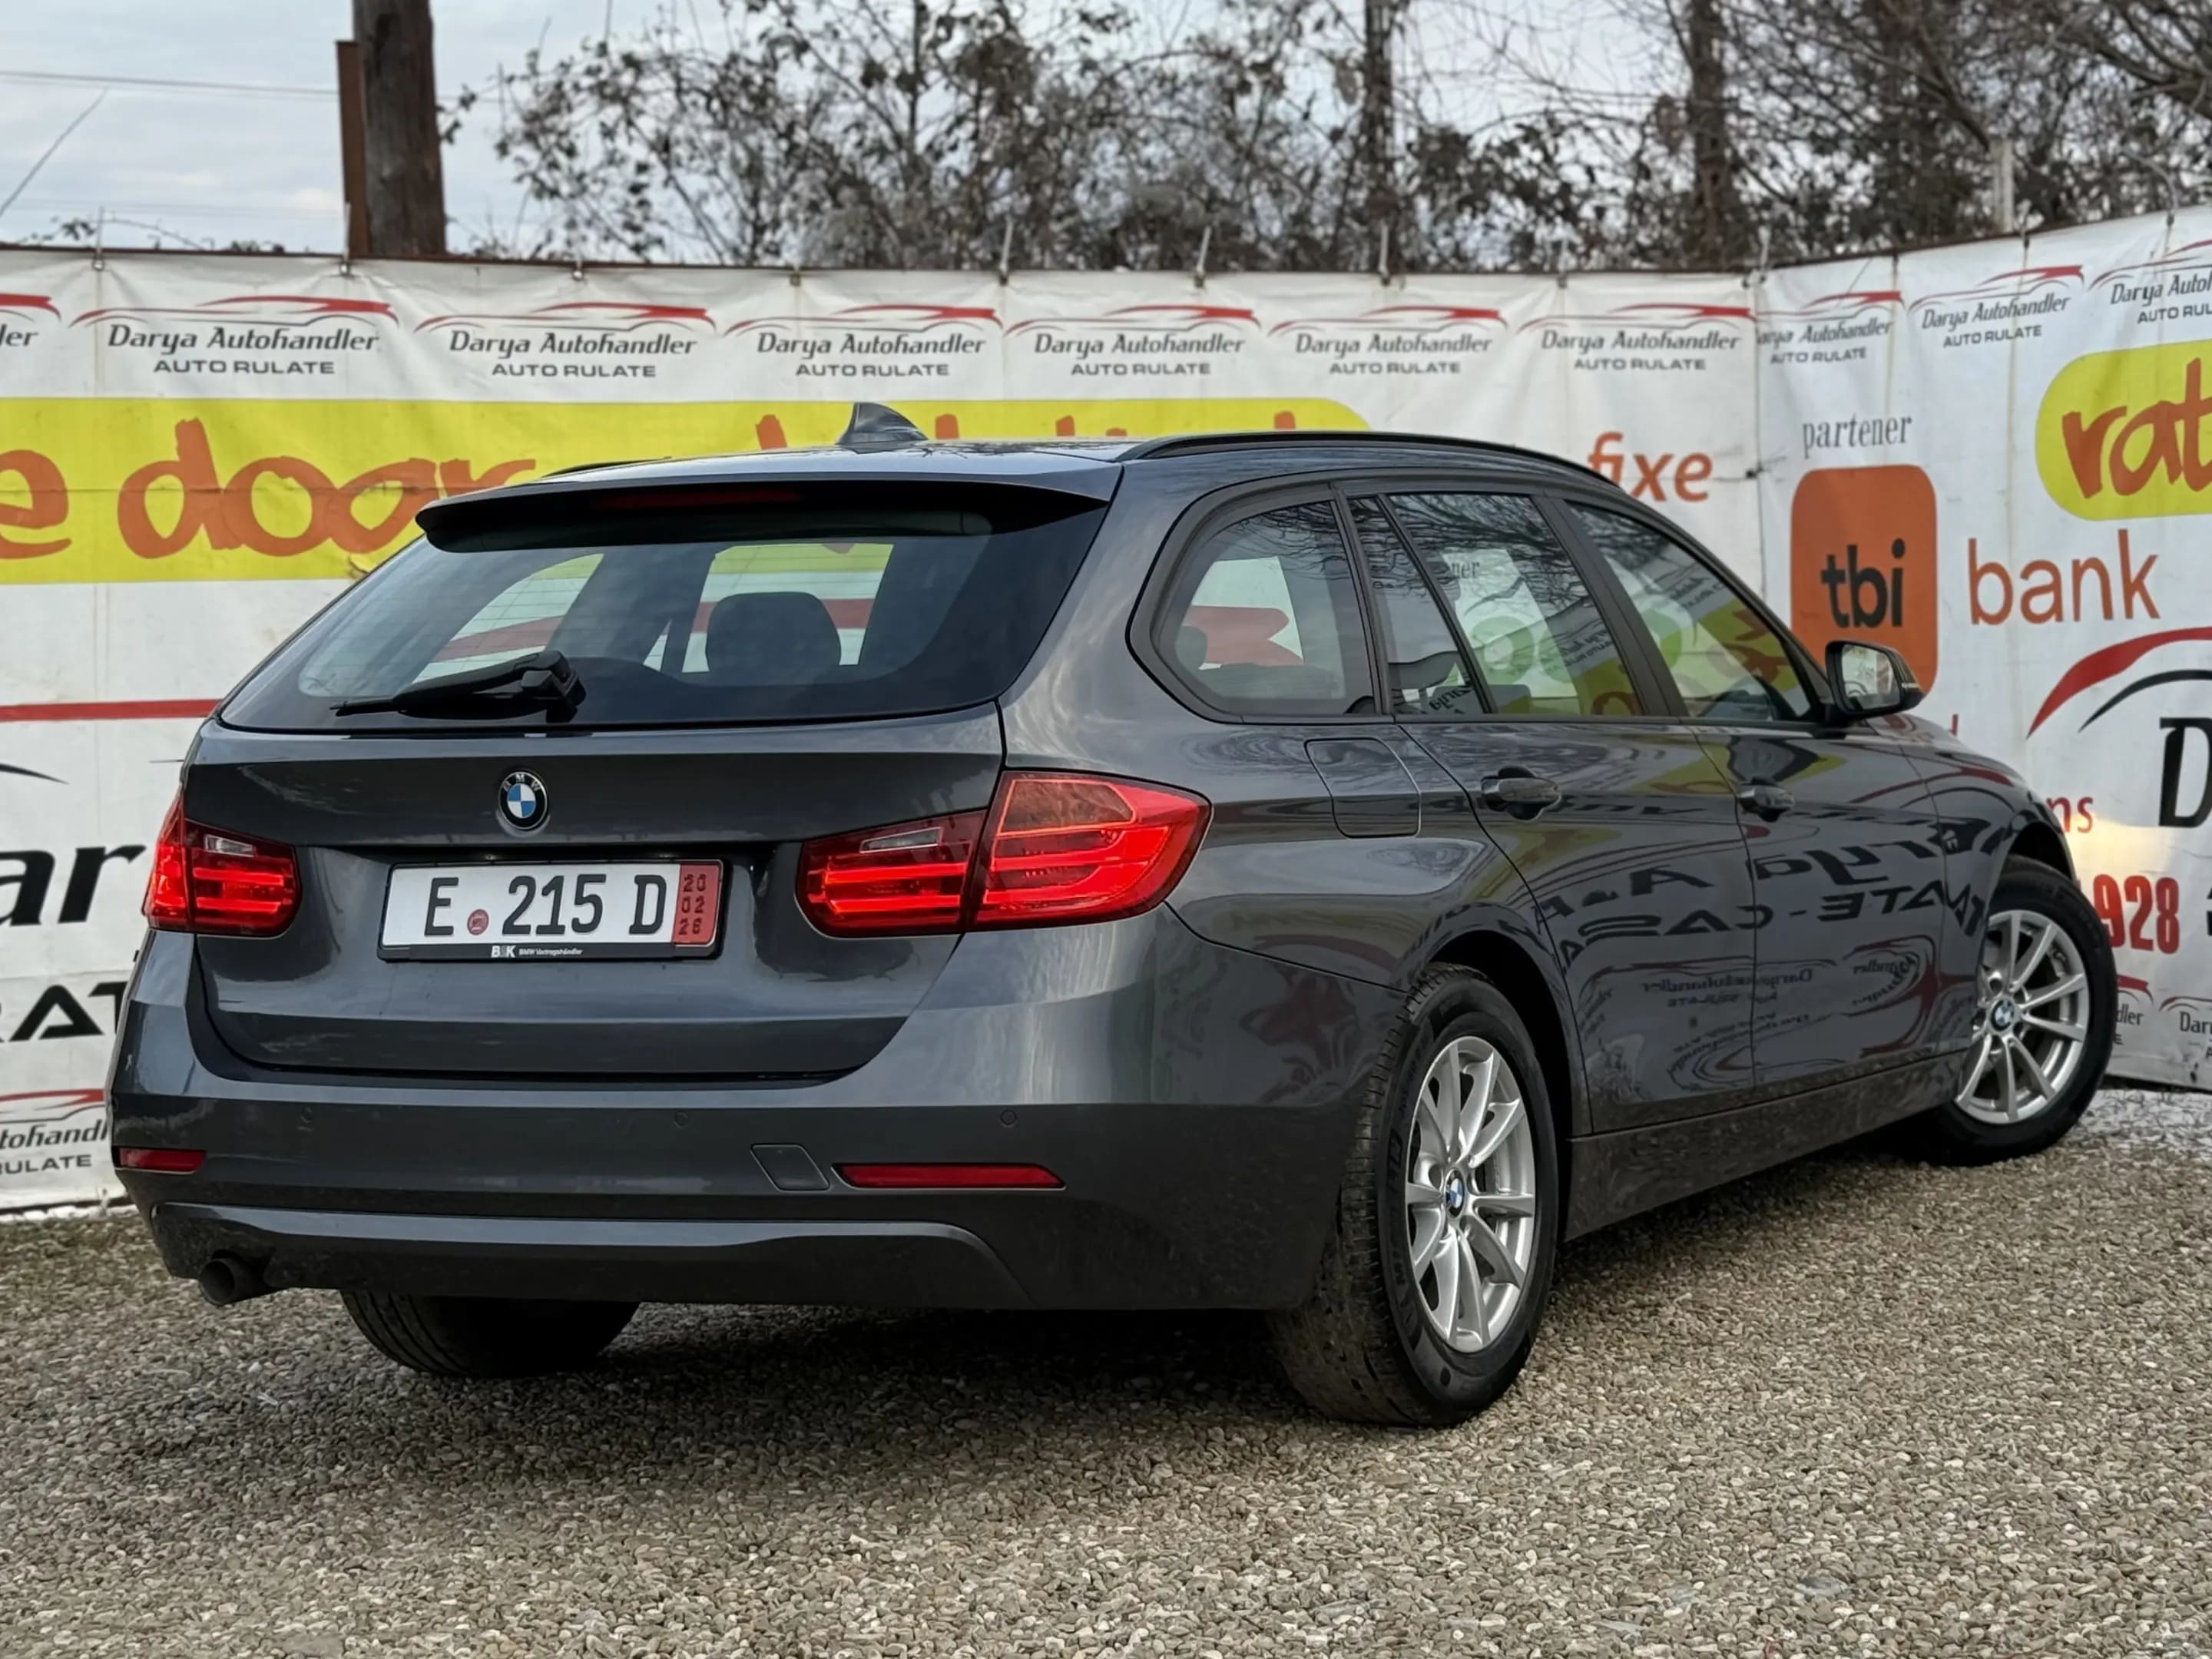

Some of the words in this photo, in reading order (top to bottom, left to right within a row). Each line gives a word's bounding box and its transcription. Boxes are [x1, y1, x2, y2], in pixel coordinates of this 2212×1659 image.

[2111, 281, 2163, 307] Darya
[1921, 308, 1969, 332] Darya
[1972, 293, 2071, 323] Autohandler
[2137, 307, 2180, 324] AUTO
[108, 324, 197, 354] Darya
[207, 327, 379, 350] Autohandler
[1541, 329, 1604, 354] Darya
[1611, 329, 1743, 352] Autohandler
[1799, 317, 1895, 343] Autohandler
[1942, 333, 1982, 348] AUTO
[1984, 324, 2043, 343] RULATE
[449, 330, 530, 359] Darya
[539, 333, 698, 355] Autohandler
[757, 332, 832, 359] Darya
[839, 333, 987, 355] Autohandler
[1034, 333, 1104, 359] Darya
[1111, 333, 1246, 355] Autohandler
[1295, 333, 1360, 359] Darya
[1367, 333, 1492, 354] Autohandler
[1770, 352, 1808, 364] AUTO
[1812, 346, 1867, 363] RULATE
[153, 359, 227, 373] AUTO
[233, 359, 336, 375] RULATE
[492, 363, 558, 376] AUTO
[563, 364, 657, 378] RULATE
[795, 363, 857, 376] AUTO
[862, 363, 949, 376] RULATE
[1071, 363, 1128, 376] AUTO
[1132, 362, 1211, 375] RULATE
[1329, 361, 1382, 375] AUTO
[1386, 360, 1462, 374] RULATE
[1574, 358, 1627, 370] AUTO
[1631, 357, 1707, 371] RULATE
[1803, 416, 1912, 459] partener
[1821, 538, 1905, 628] tbi
[1969, 529, 2161, 626] bank
[2047, 796, 2094, 833] ns
[683, 873, 707, 892] 20
[424, 877, 459, 936] E
[502, 873, 607, 935] 215
[628, 874, 667, 935] D
[680, 895, 705, 914] 02
[0, 1154, 92, 1174] ULATE
